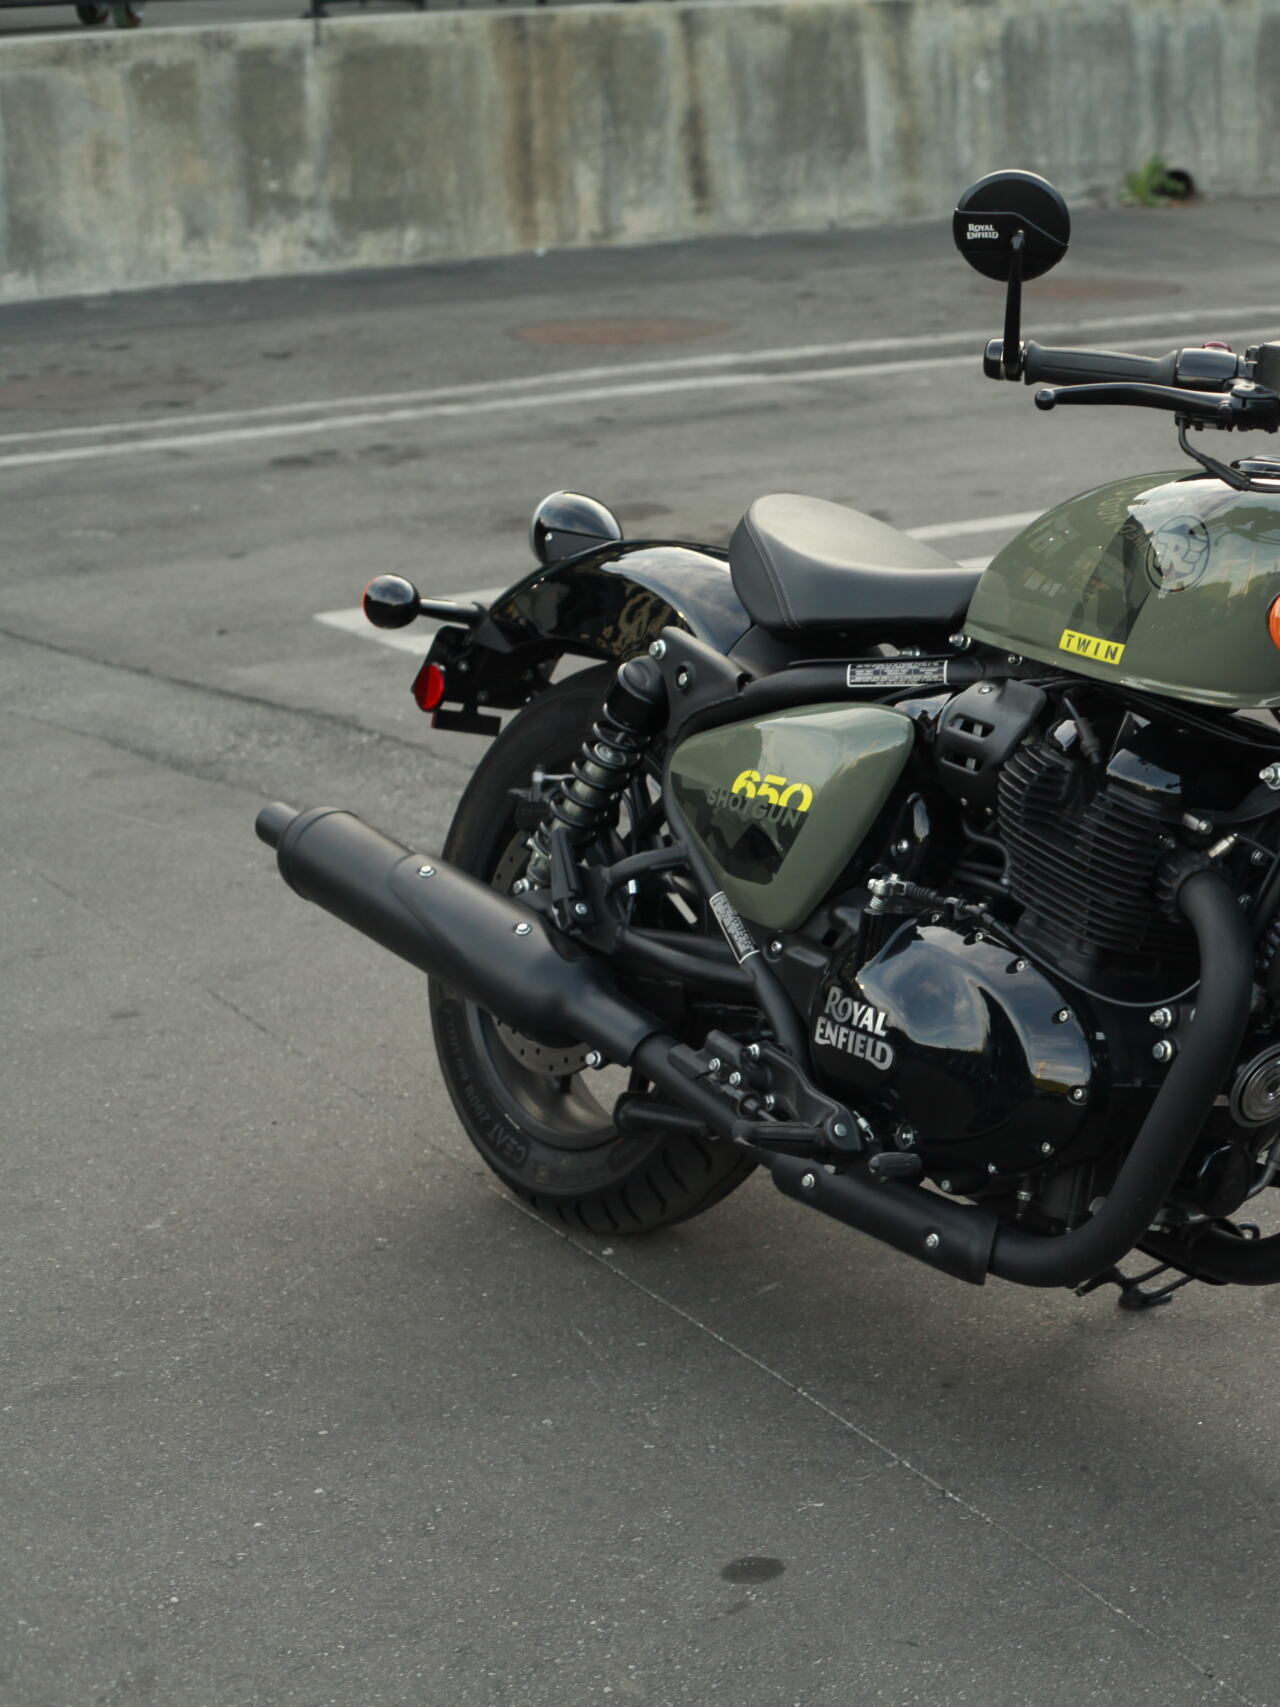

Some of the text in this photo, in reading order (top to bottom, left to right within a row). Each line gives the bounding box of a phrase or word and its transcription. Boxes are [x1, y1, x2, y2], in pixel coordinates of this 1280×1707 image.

[966, 231, 998, 239] ENFIELD
[968, 223, 994, 231] ROYAL
[1065, 633, 1120, 661] TWIN
[706, 786, 801, 830] SHOTGUN
[731, 769, 813, 813] 650
[824, 985, 888, 1037] ROYAL
[814, 1016, 894, 1071] ENFIELD
[489, 1124, 527, 1164] CEAT
